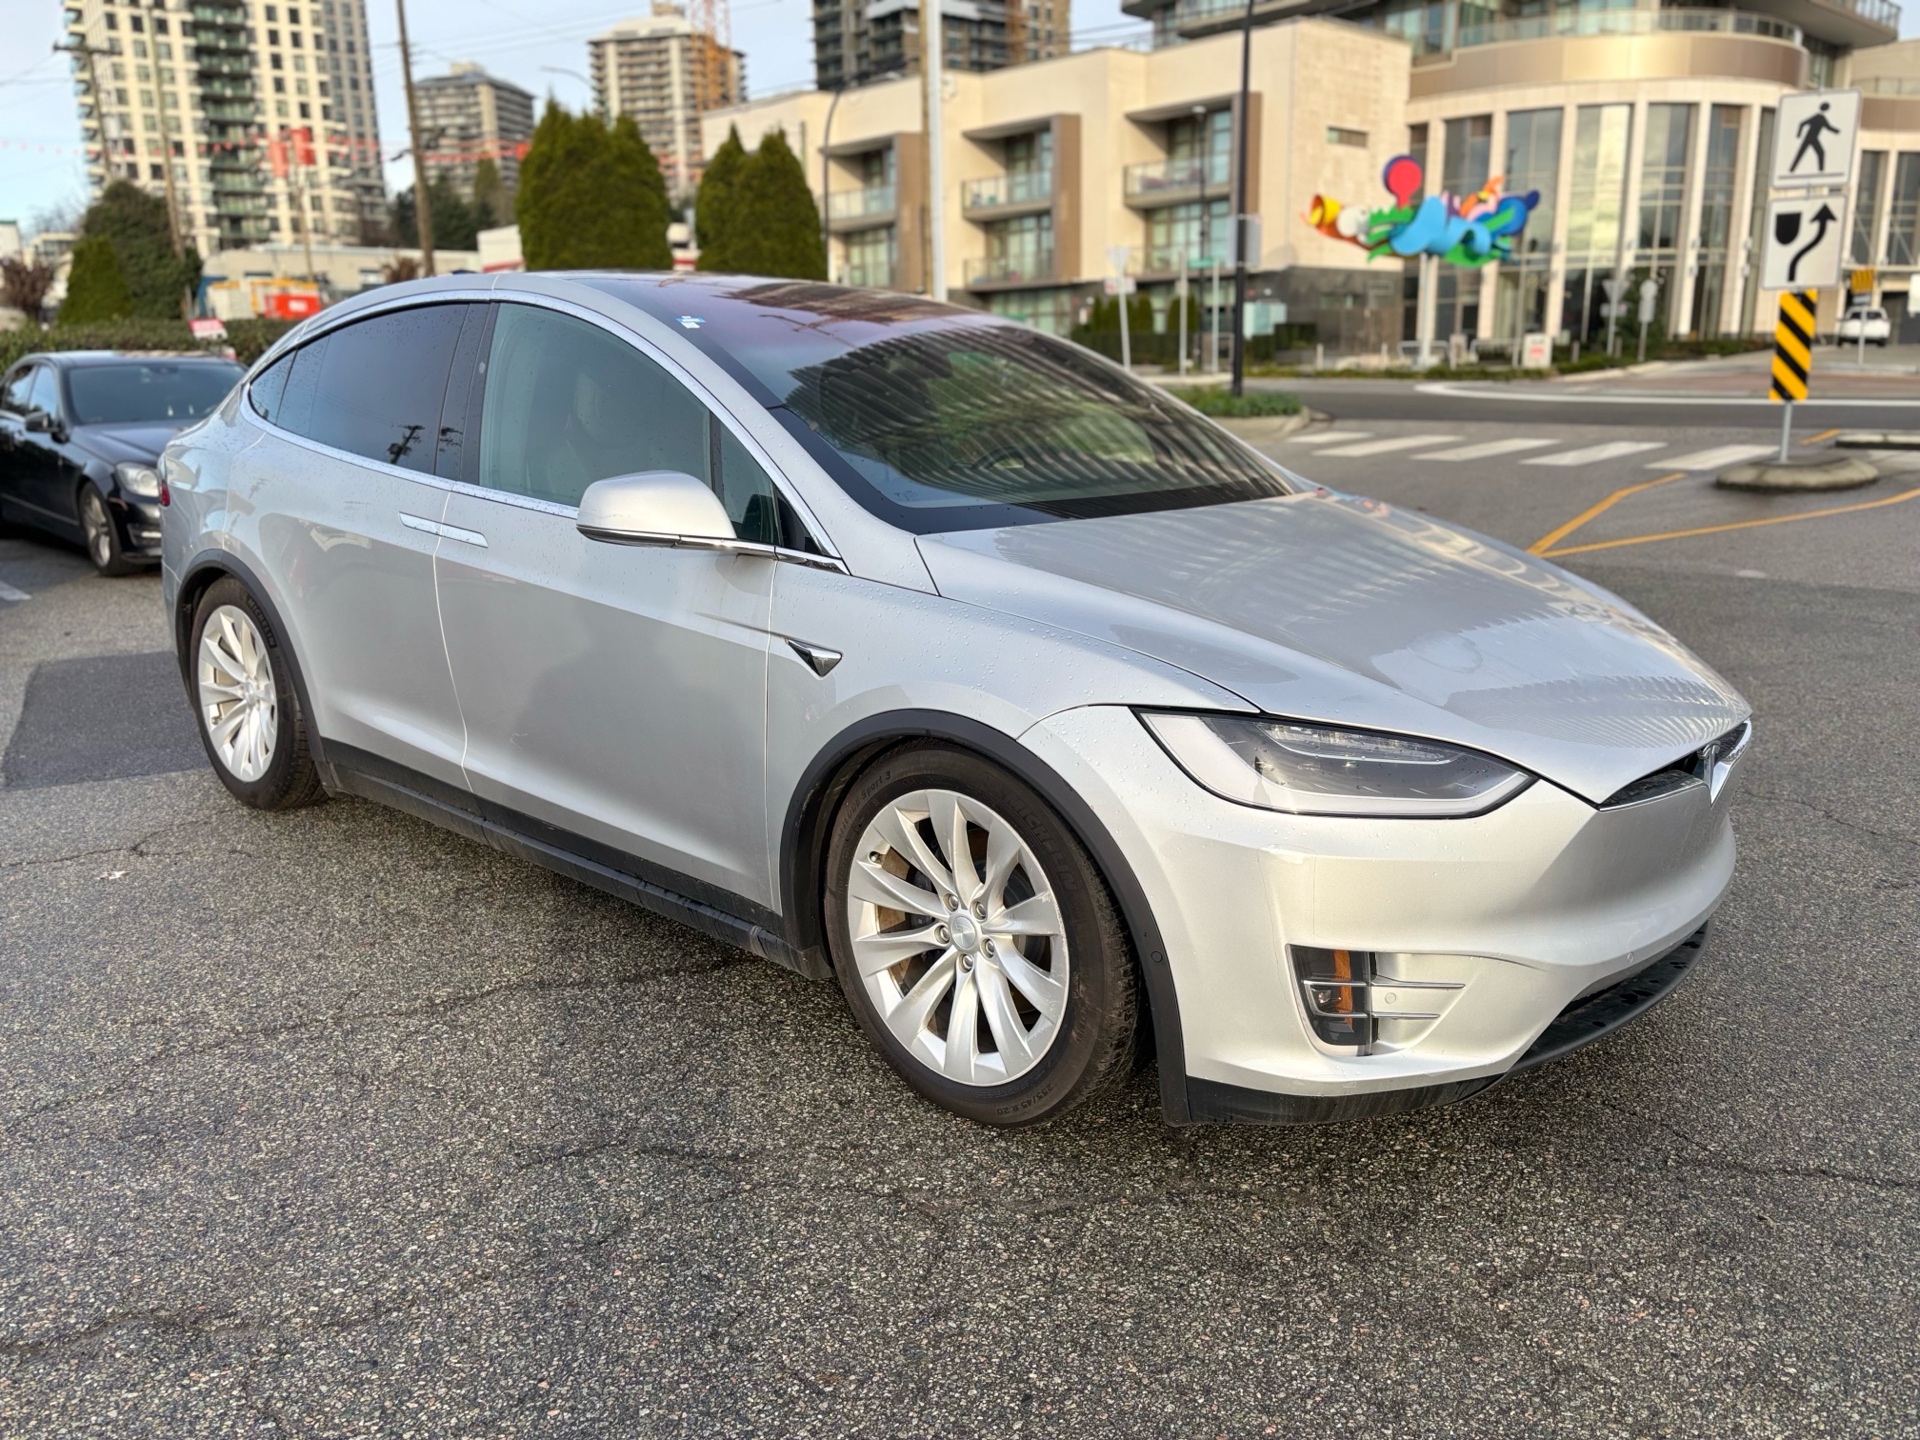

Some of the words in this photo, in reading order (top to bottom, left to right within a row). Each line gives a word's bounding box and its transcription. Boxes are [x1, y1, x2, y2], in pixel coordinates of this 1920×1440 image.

[861, 775, 883, 800] Sport
[1003, 792, 1079, 890] MICHELIN
[1020, 1083, 1054, 1109] 255/45
[996, 1107, 1010, 1115] 20
